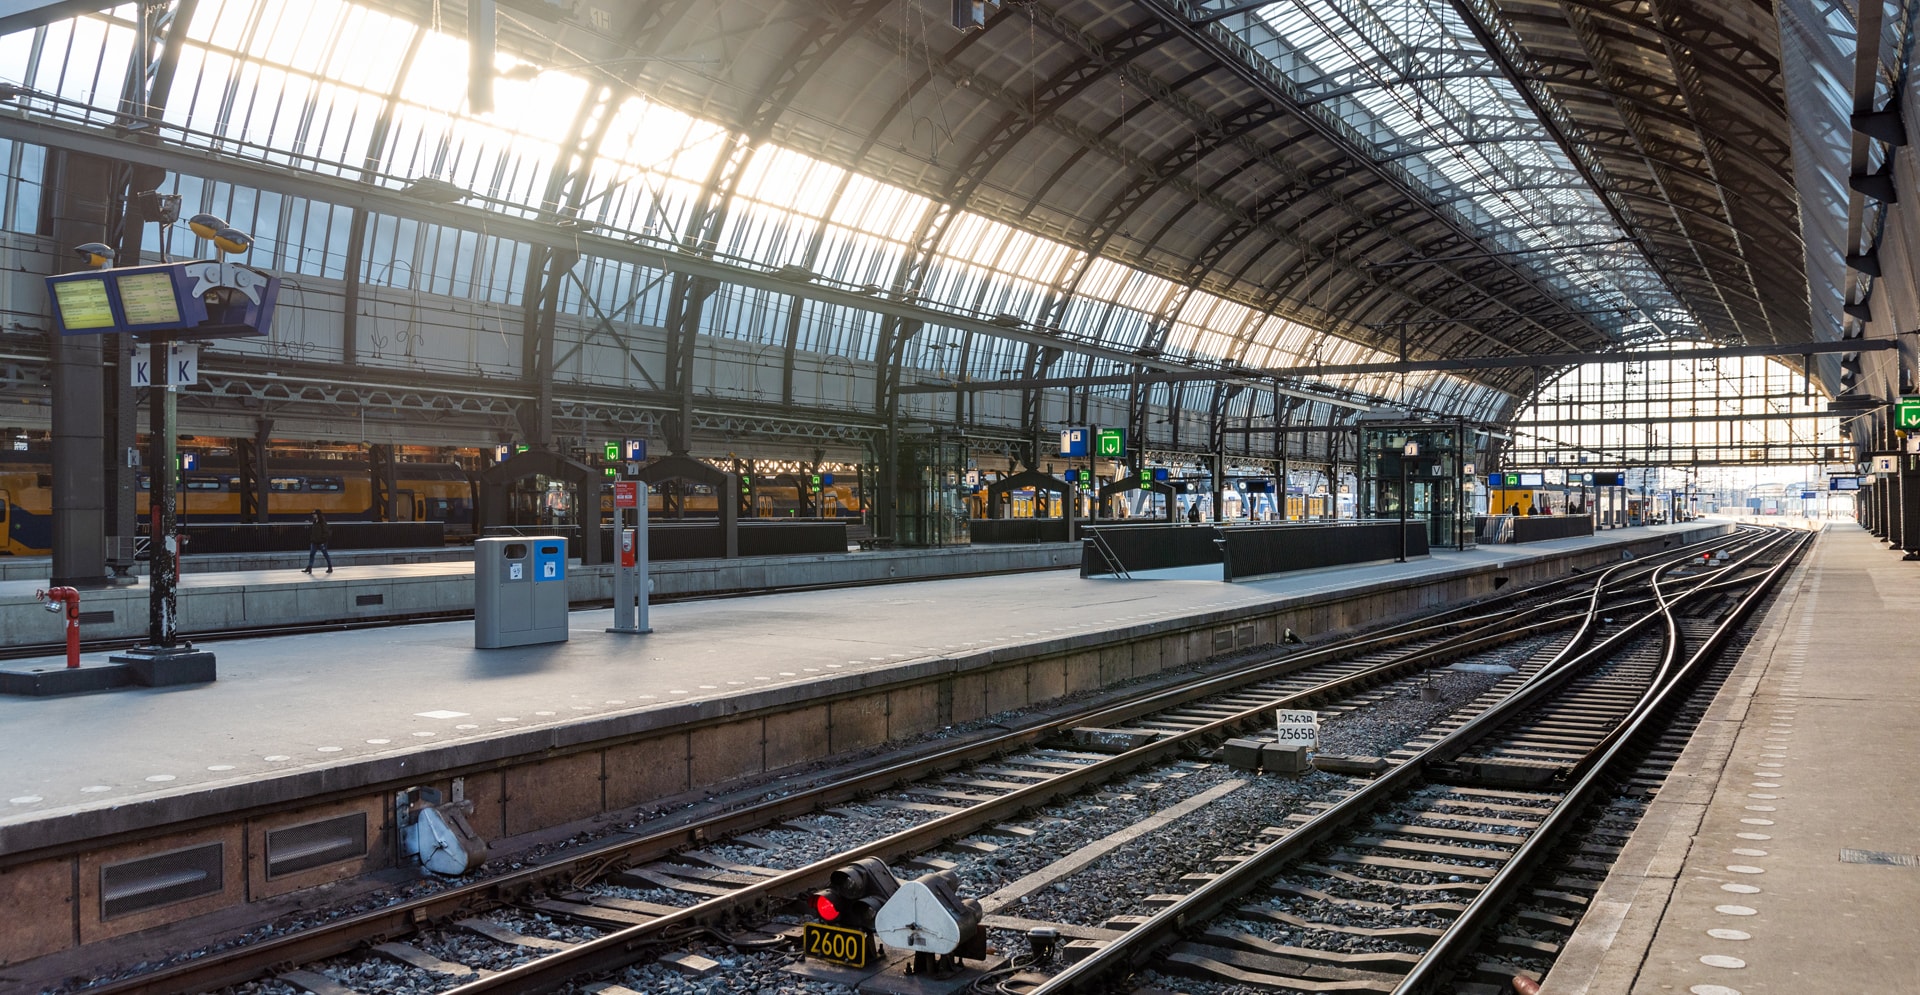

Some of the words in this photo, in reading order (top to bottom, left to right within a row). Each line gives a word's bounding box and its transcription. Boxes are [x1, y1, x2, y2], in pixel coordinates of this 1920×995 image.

[137, 362, 148, 383] K
[178, 360, 190, 382] K
[1433, 467, 1441, 475] V
[1862, 463, 1871, 473] V
[1280, 728, 1315, 740] 2565B
[811, 929, 857, 960] 2600
